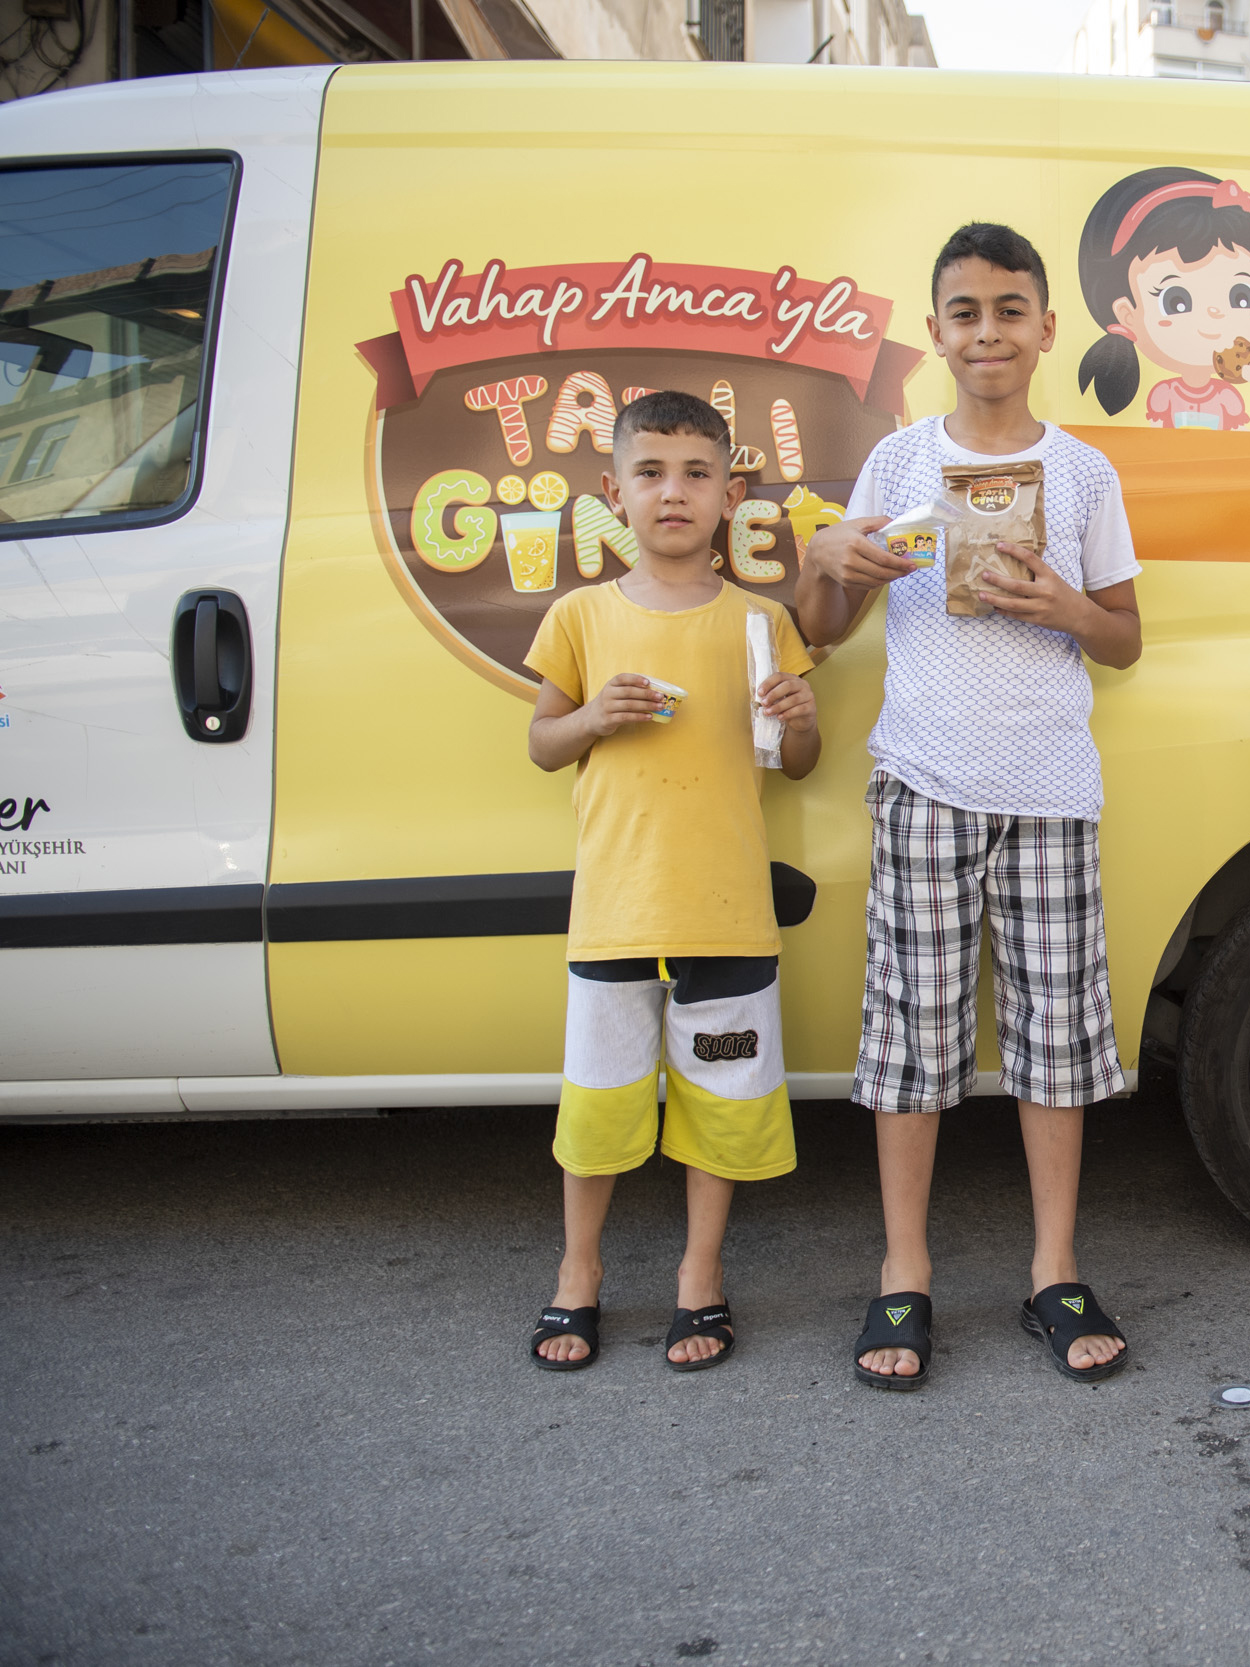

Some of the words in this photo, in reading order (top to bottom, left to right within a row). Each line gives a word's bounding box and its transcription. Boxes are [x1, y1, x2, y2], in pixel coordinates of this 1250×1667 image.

[410, 262, 584, 346] Vahap
[464, 370, 804, 482] TALI
[410, 469, 847, 594] GÜNER
